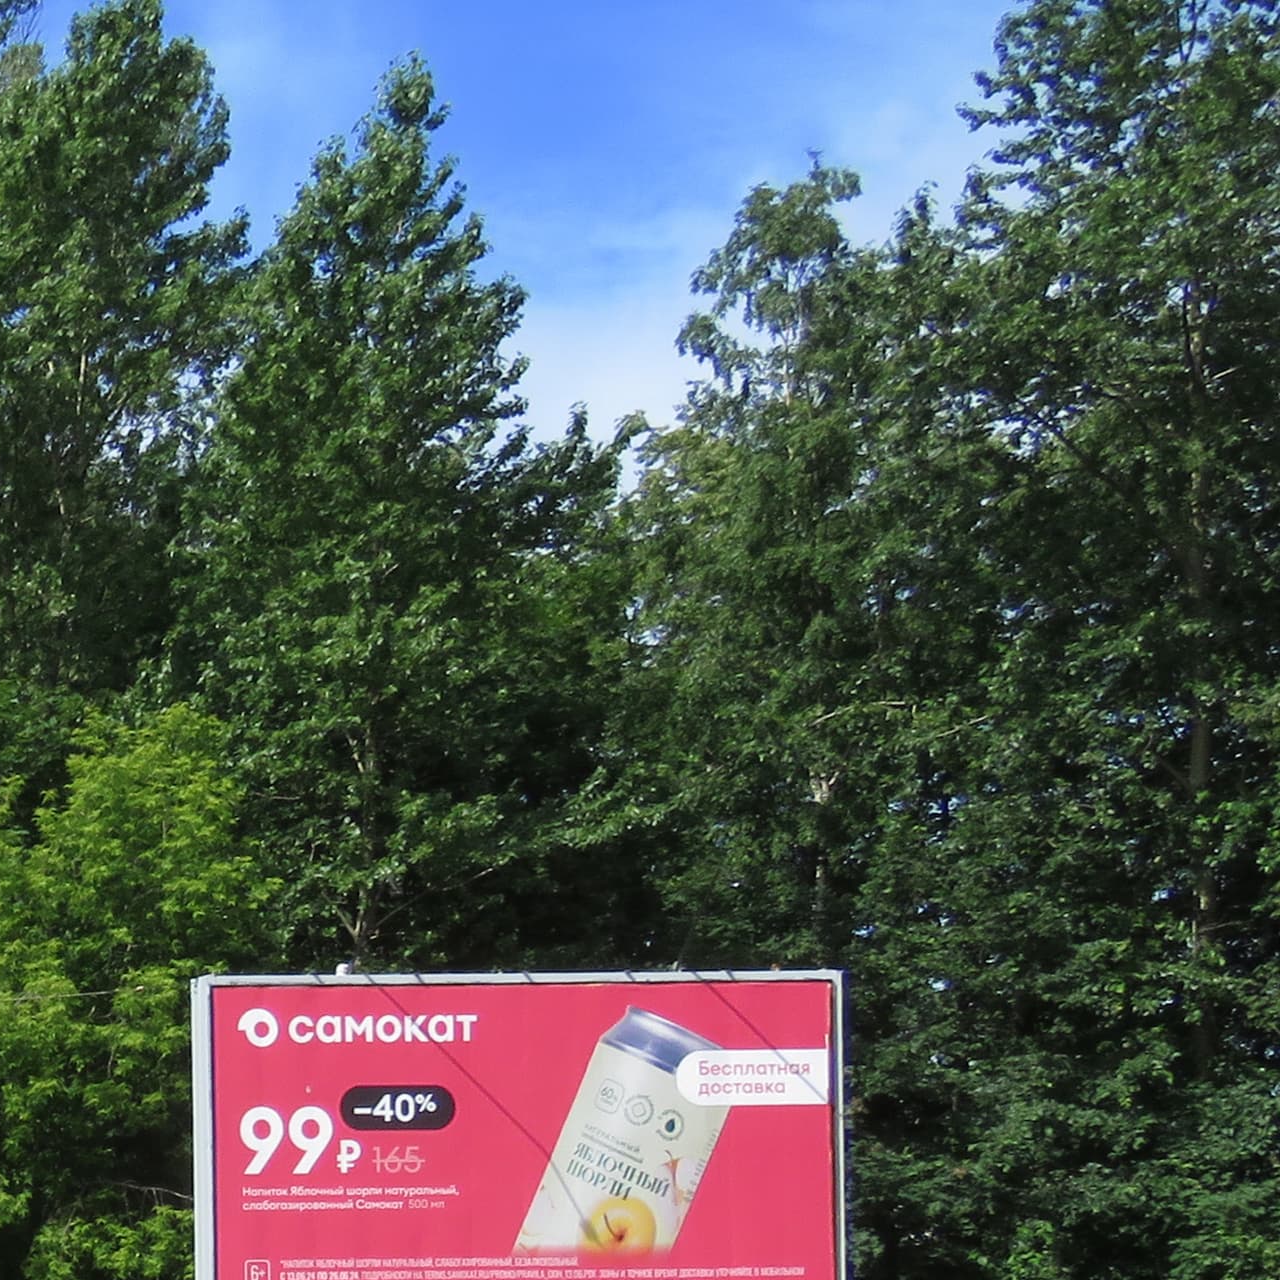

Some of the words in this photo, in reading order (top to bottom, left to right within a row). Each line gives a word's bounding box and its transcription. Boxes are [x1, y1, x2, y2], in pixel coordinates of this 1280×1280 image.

[288, 1014, 478, 1044] самокат
[698, 1060, 811, 1076] Бесплатная
[698, 1081, 786, 1097] доставка
[372, 1146, 426, 1174] 165
[573, 1142, 671, 1197] ЯБЛОЧНЫЙ
[566, 1159, 632, 1201] ШОРЛИ
[242, 1186, 288, 1197] Напиток
[290, 1185, 344, 1197] Яблочный
[384, 1185, 460, 1199] натуральный,
[242, 1199, 354, 1212] слабогазированный
[356, 1199, 404, 1210] Самокат
[408, 1200, 427, 1209] 500
